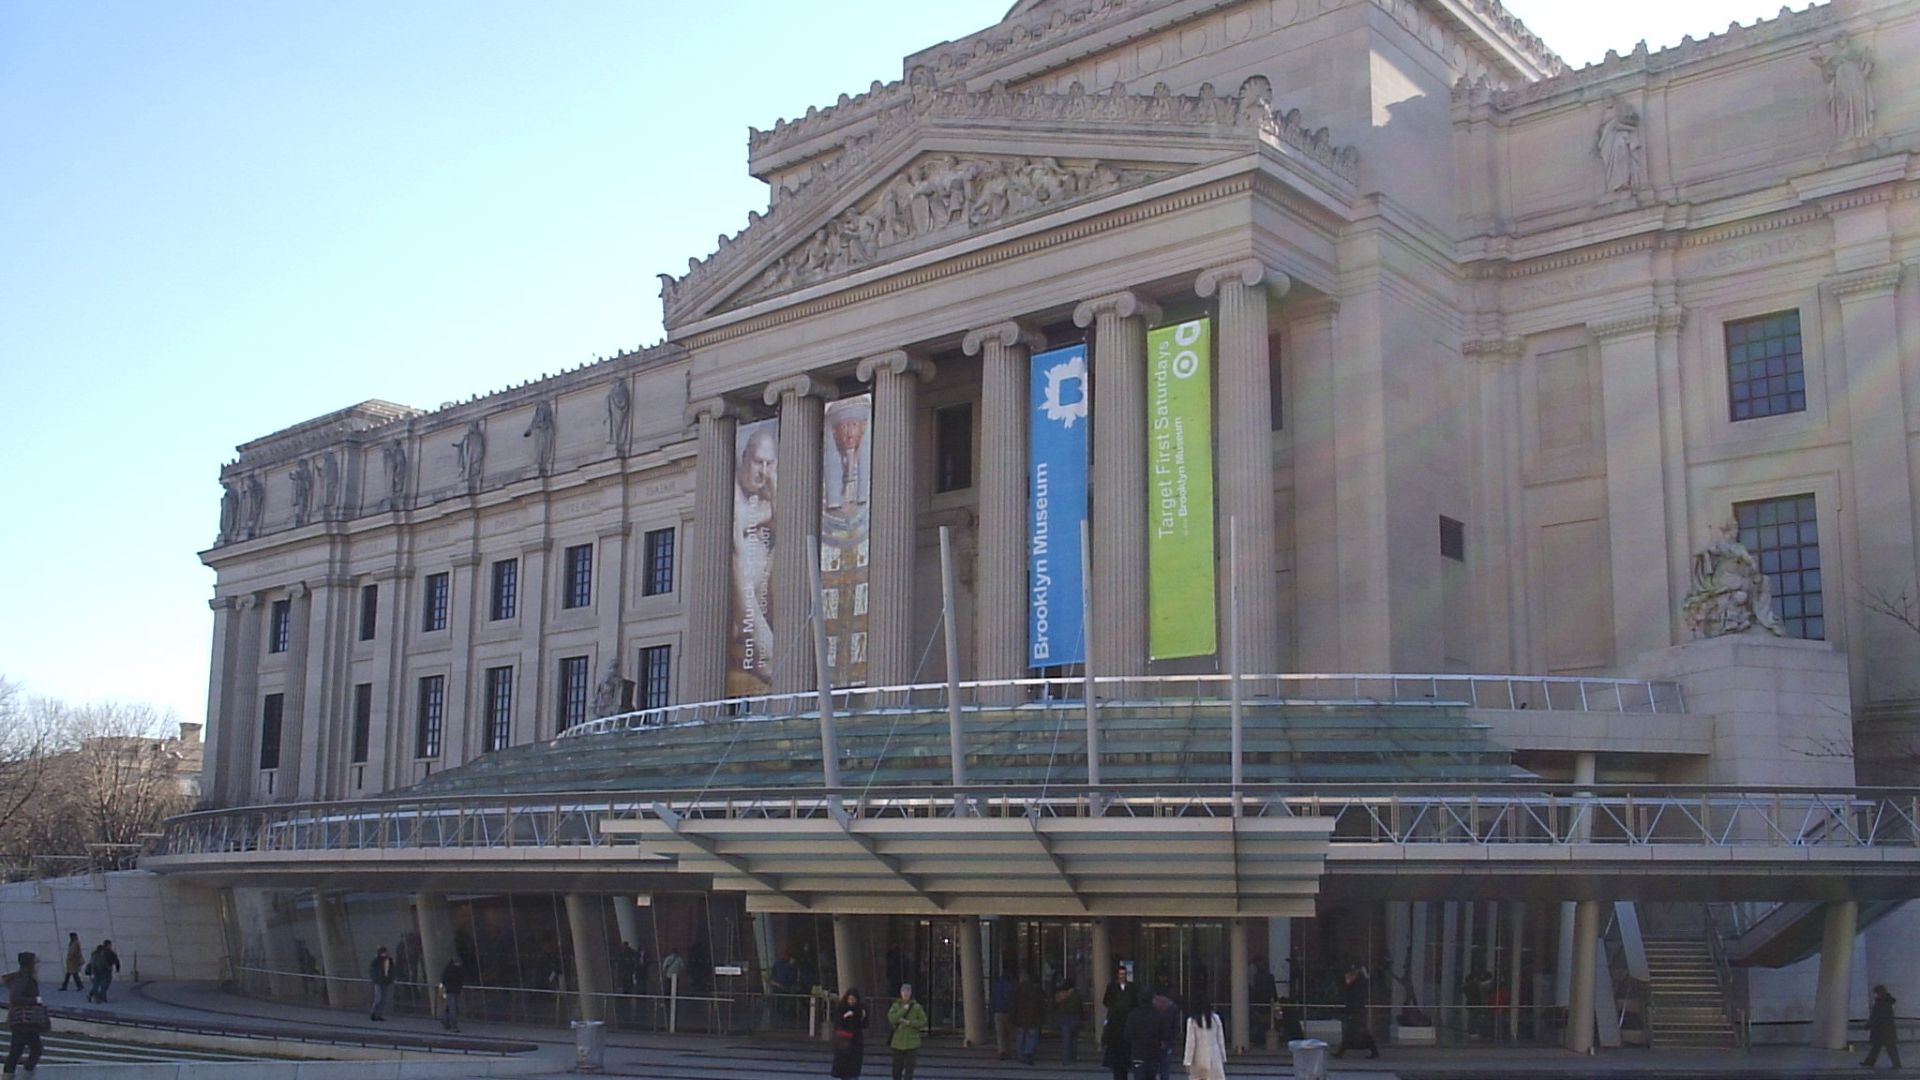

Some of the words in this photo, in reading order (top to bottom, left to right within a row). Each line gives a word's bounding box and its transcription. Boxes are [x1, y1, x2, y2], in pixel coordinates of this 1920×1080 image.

[1154, 341, 1171, 429] Saturdays
[1155, 433, 1171, 475] First
[1033, 463, 1047, 555] Museum
[1158, 480, 1177, 540] Target
[1177, 465, 1188, 517] Brooklyn
[1033, 559, 1051, 660] Brooklyn
[742, 638, 754, 670] Ron
